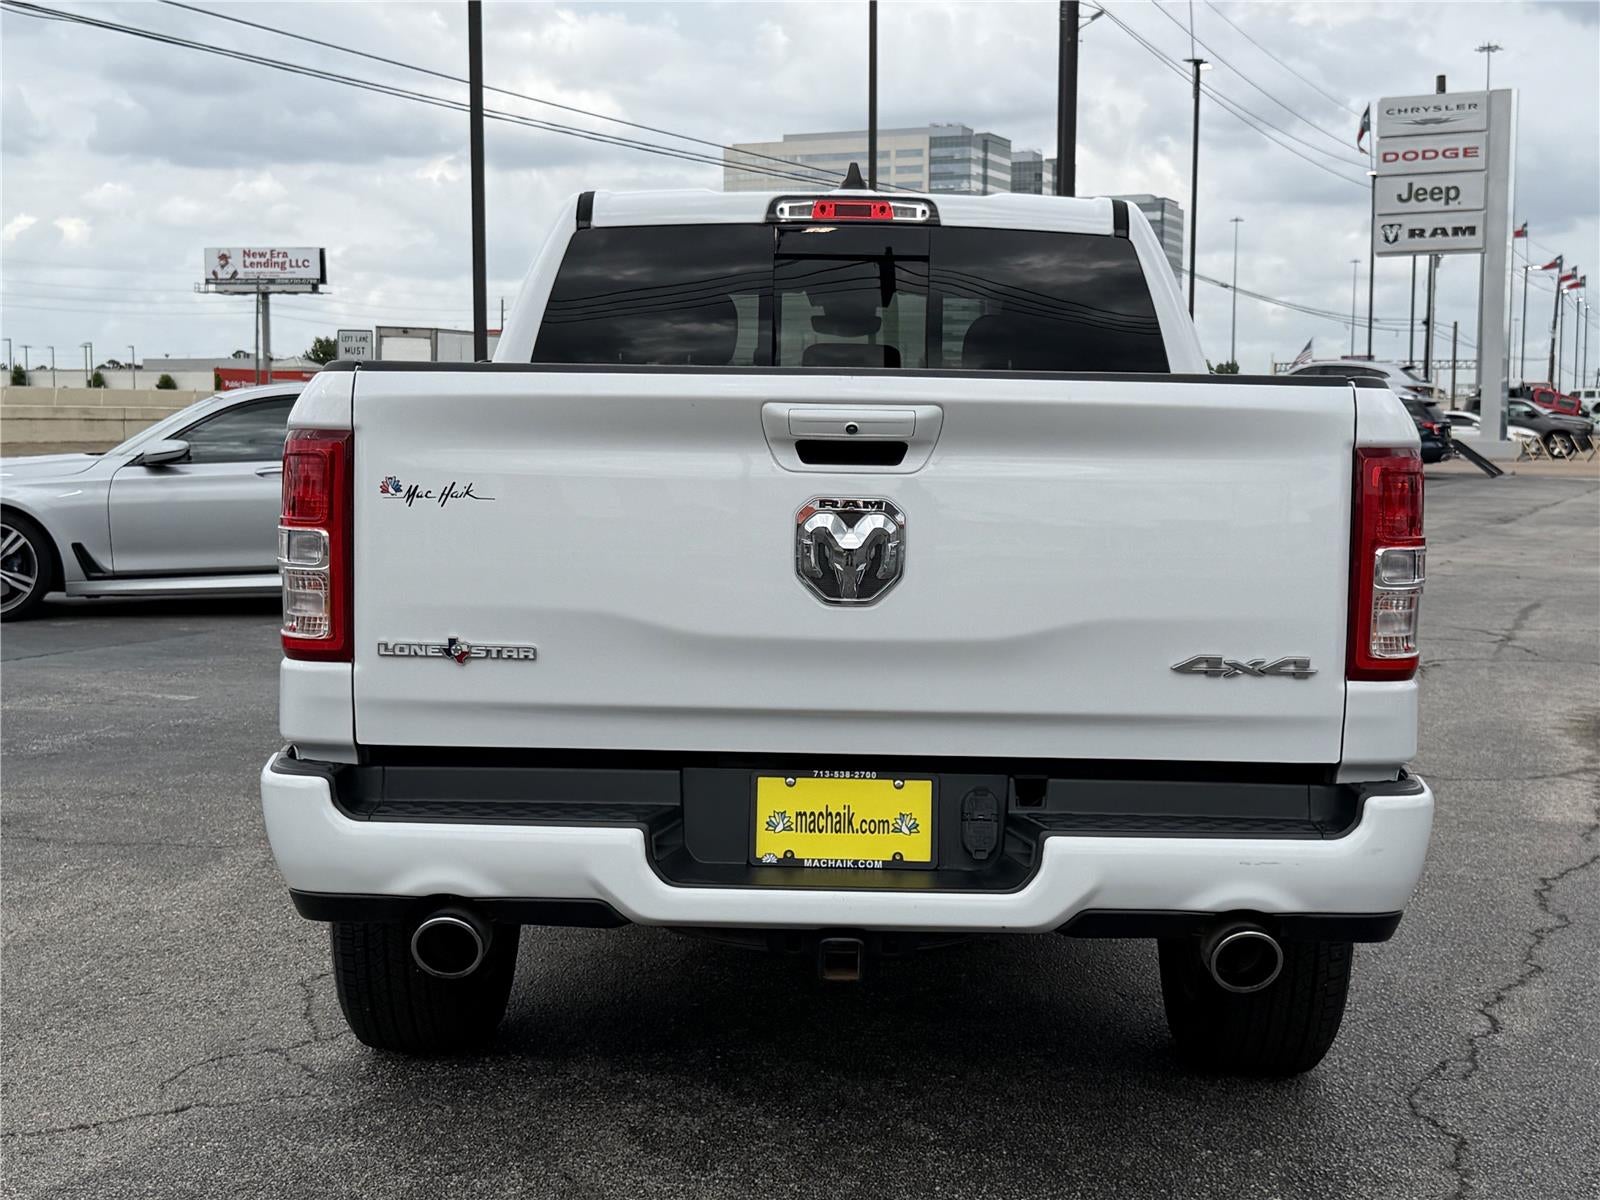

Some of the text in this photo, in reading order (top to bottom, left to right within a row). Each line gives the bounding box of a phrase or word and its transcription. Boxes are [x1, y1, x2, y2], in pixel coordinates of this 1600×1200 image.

[1386, 103, 1478, 116] CHRYSLER
[1382, 146, 1480, 163] DODGE
[1396, 182, 1461, 206] Jeep
[1407, 225, 1477, 239] RAM
[242, 249, 288, 259] New Era
[243, 258, 310, 271] Lending LLC
[341, 335, 353, 343] LEFT
[344, 346, 365, 355] MUST
[402, 481, 495, 507] Mac Haik
[818, 499, 886, 511] RAM
[378, 642, 537, 660] LONE STAR
[813, 769, 877, 779] 713-538-2700
[794, 804, 890, 835] machaik.com
[803, 858, 883, 869] MACHAIK.COM
